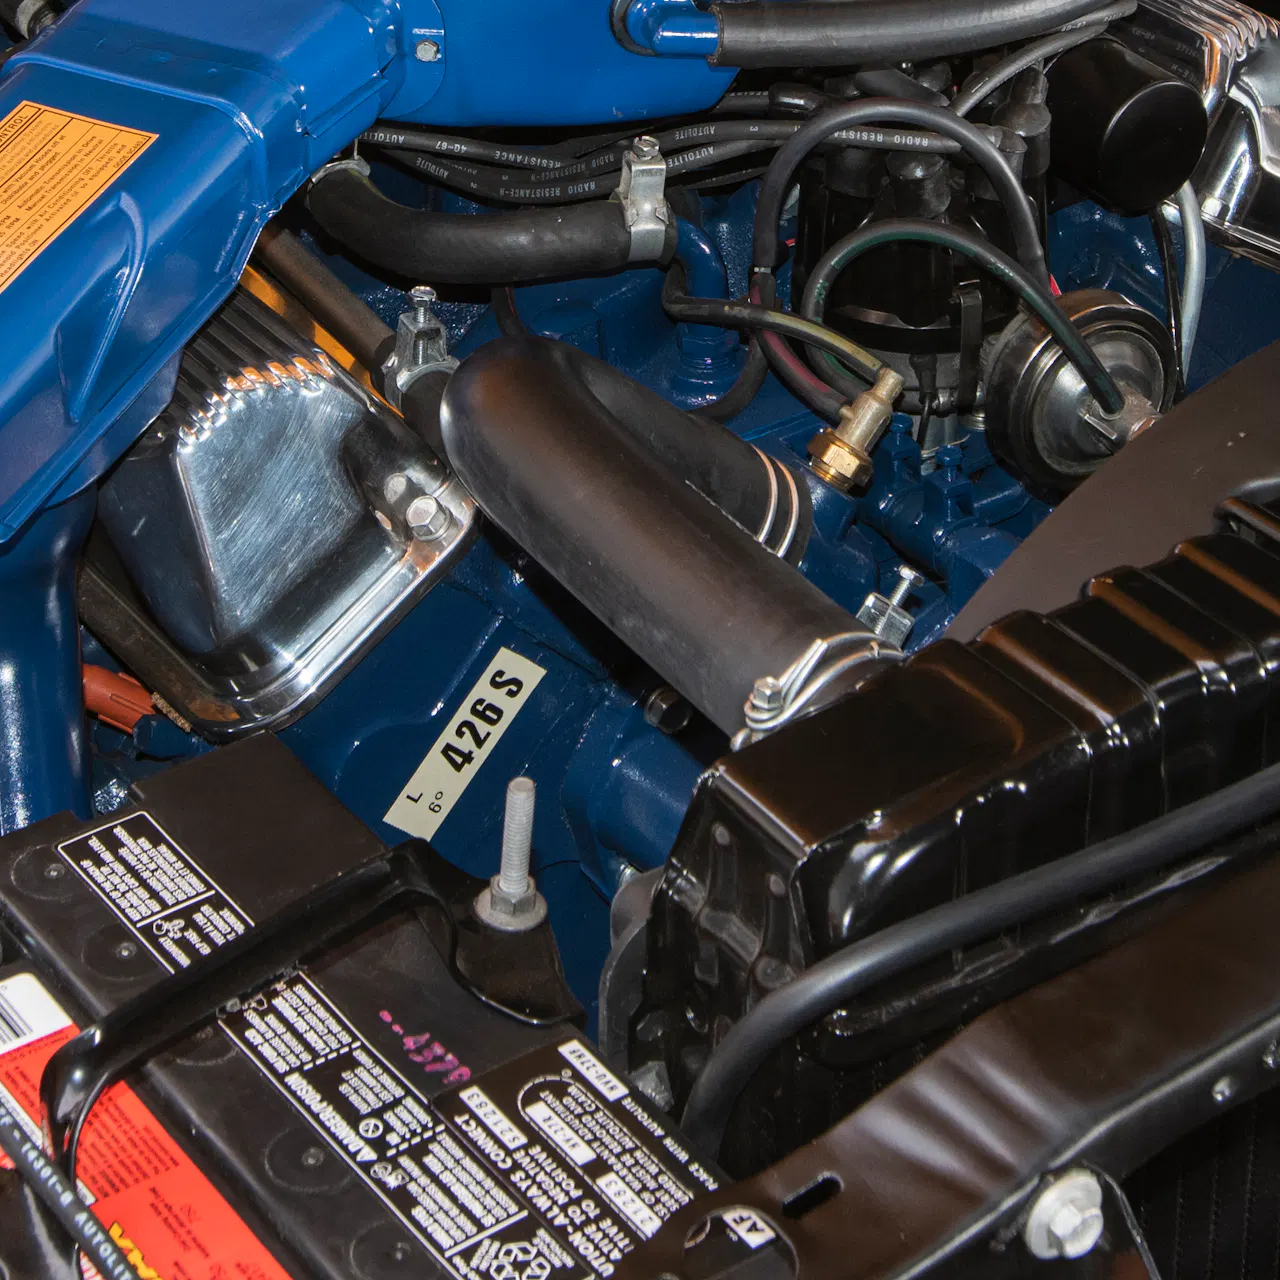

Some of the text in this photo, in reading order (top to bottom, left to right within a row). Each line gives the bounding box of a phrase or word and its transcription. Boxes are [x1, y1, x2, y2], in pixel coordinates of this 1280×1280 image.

[494, 150, 562, 168] RESISTANCE
[667, 146, 714, 168] AUTOLITE
[894, 134, 929, 147] RADIO
[568, 181, 596, 194] RADIO
[440, 669, 523, 773] 426 S
[406, 791, 423, 804] L
[281, 1069, 367, 1154] DANGER/POISON
[537, 1088, 595, 1142] ADJUSTMENT
[619, 1095, 667, 1138] AUTOLITE
[559, 1094, 682, 1212] SERT MUST BE REMOVED AND
[565, 1083, 691, 1206] URNED WITH AUTOLITE CLAIM
[589, 1139, 644, 1192] WARRANTY
[659, 1135, 692, 1164] WITH
[451, 1109, 617, 1279] UTION-ALWAYS CONNECT
[525, 1143, 636, 1253] ITIVE TO POSITIVE
[685, 1160, 720, 1192] PLACE
[510, 1147, 624, 1263] ATIVE TO NEGATIVE
